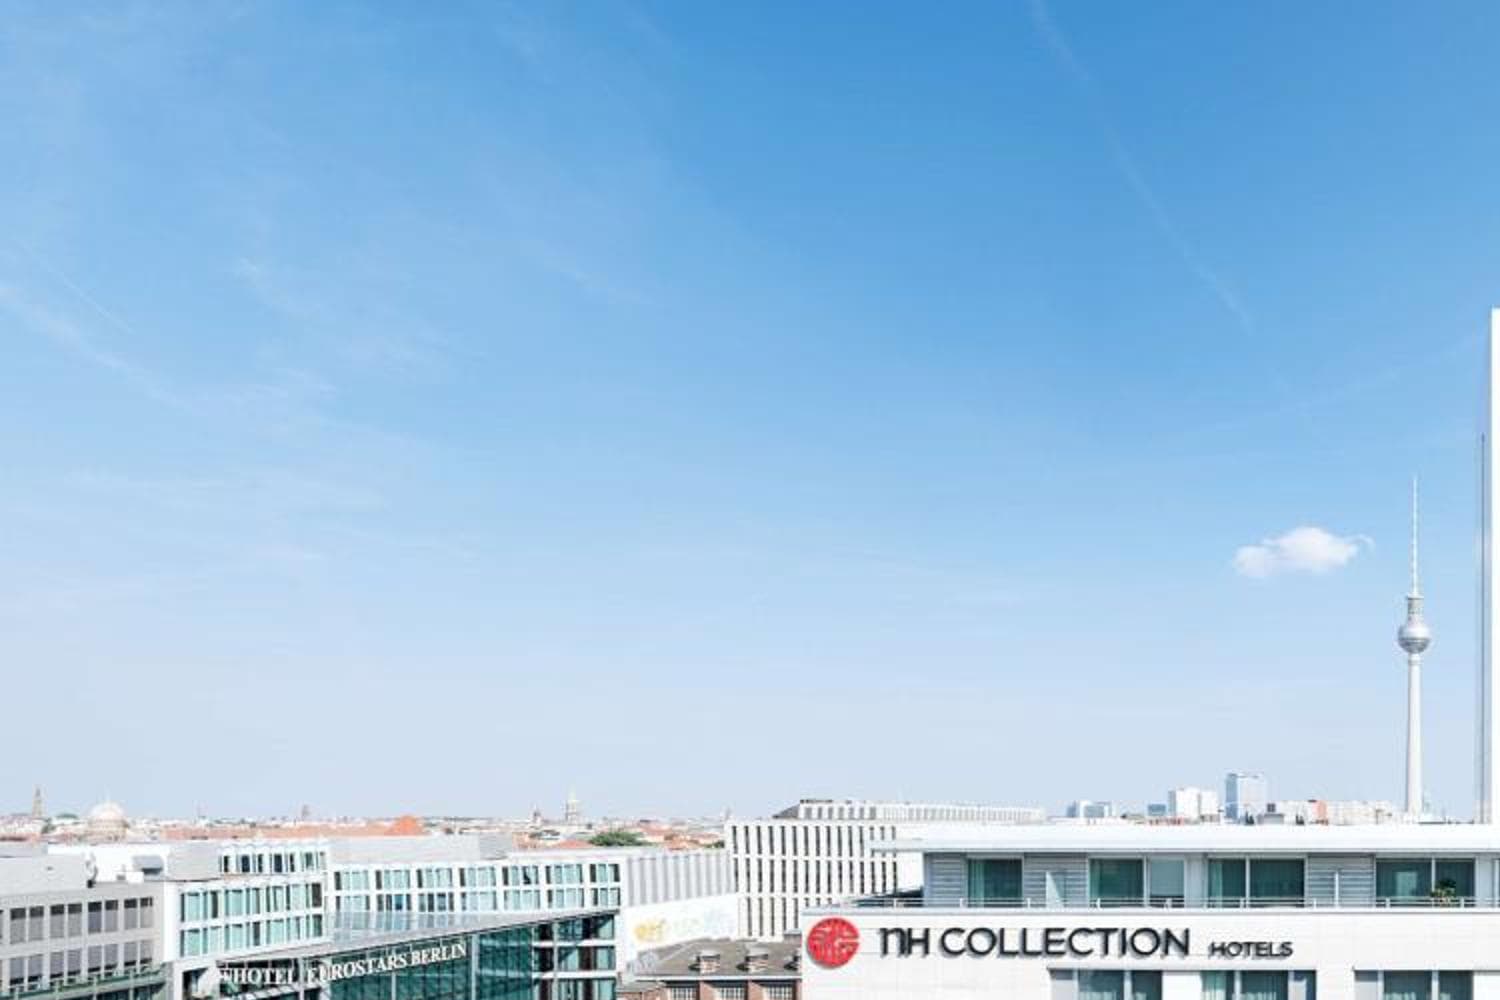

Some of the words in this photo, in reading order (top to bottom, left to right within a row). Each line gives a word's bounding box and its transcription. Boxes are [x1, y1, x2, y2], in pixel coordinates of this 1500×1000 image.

[940, 926, 1191, 957] COLLECTION
[1207, 941, 1295, 959] HOTELS
[233, 967, 299, 985] HOTEL
[306, 952, 408, 985] EUROSTARS
[409, 942, 468, 966] BERLIN
